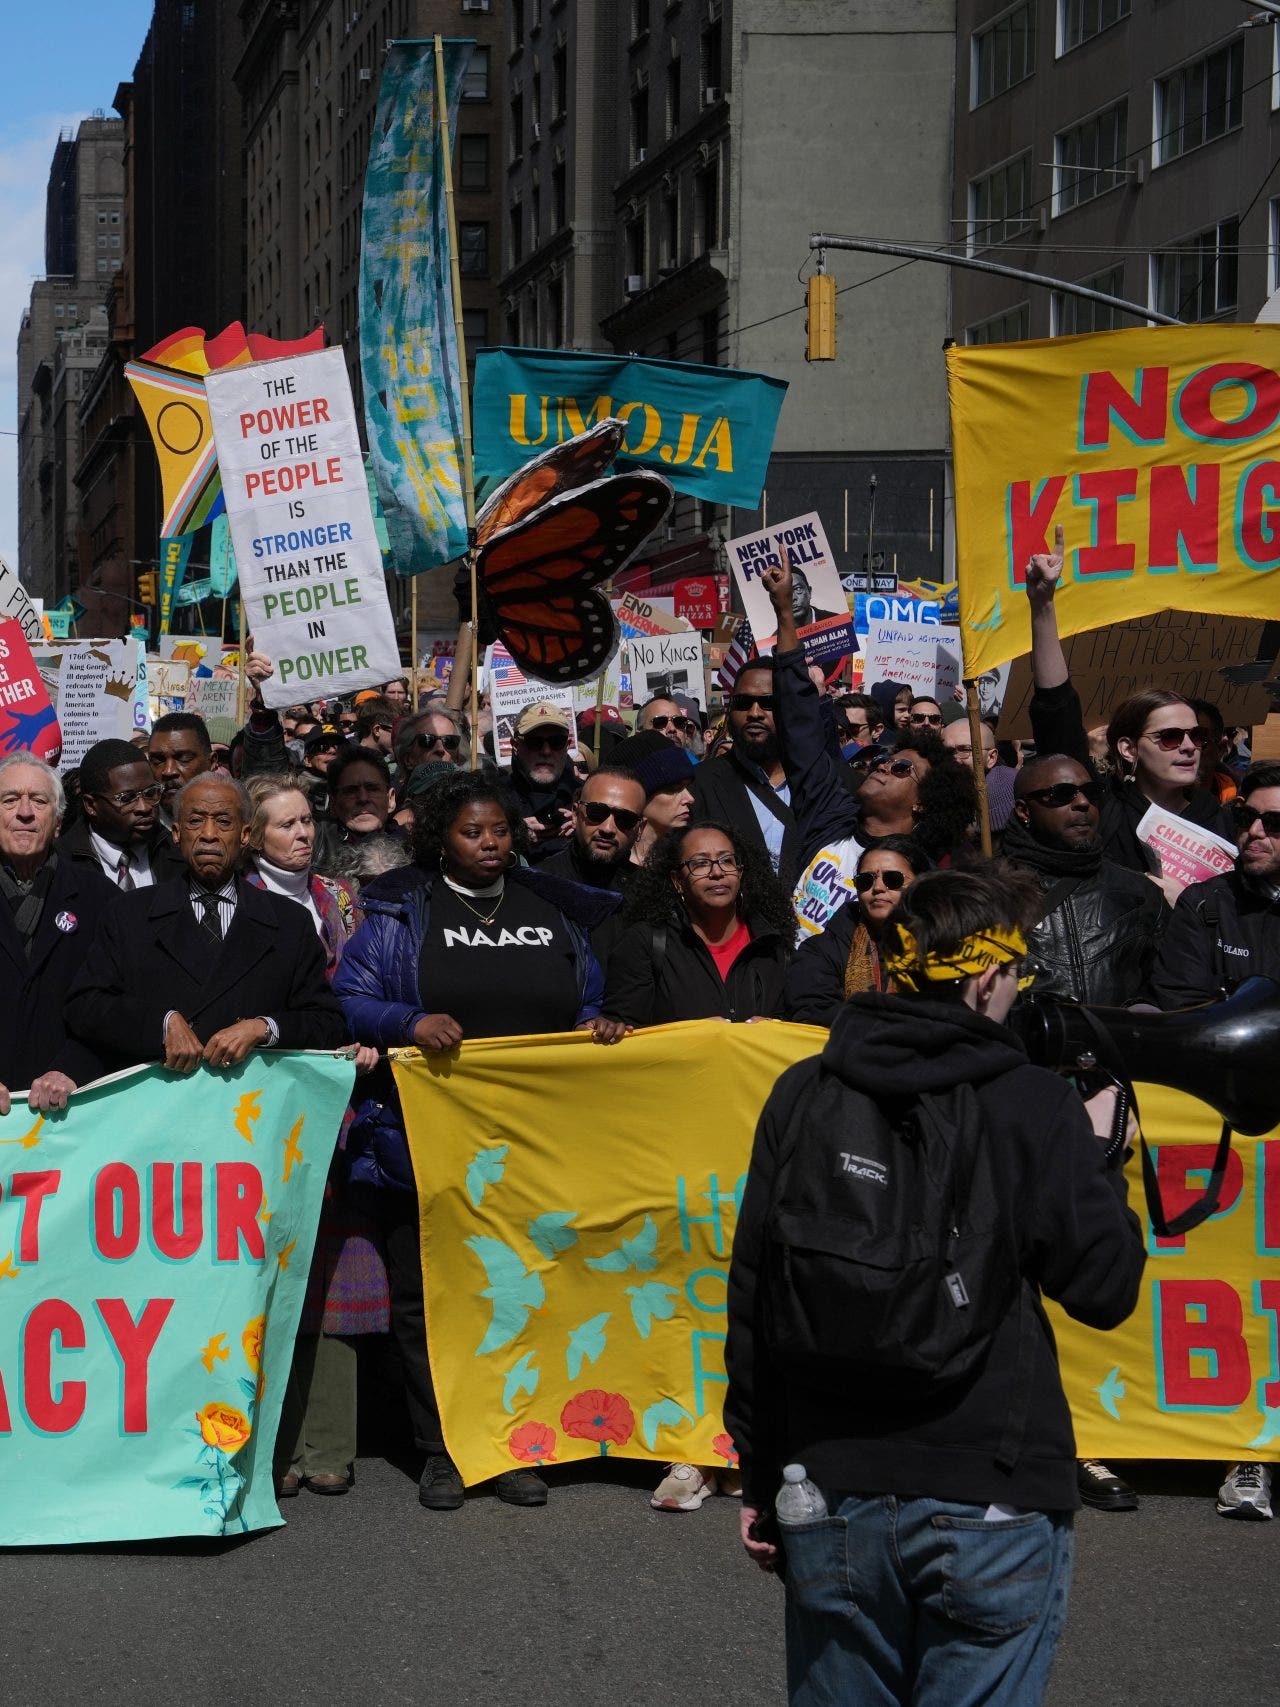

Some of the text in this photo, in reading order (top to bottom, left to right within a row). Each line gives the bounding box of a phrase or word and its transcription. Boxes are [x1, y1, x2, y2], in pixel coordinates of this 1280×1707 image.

[263, 377, 297, 398] THE
[240, 398, 331, 438] POWER
[1077, 362, 1280, 452] NO
[260, 434, 319, 460] OF THE
[508, 394, 734, 473] UMOJA
[245, 457, 344, 498] PEOPLE
[288, 502, 306, 519] IS
[252, 522, 353, 558] STRONGER
[736, 522, 818, 562] NEW YORK
[264, 553, 348, 583] THAN THE
[787, 540, 824, 569] ALL
[846, 579, 892, 587] ONE WAY
[263, 578, 362, 619] PEOPLE
[622, 594, 653, 618] END
[679, 604, 712, 612] RAY'S
[865, 597, 939, 626] OMG
[307, 620, 326, 639] IN
[810, 635, 828, 646] SHAH
[829, 629, 848, 641] ALAM
[878, 628, 956, 644] UNPAID AGITATOR
[631, 638, 698, 671] NO KINGS
[1125, 627, 1202, 666] THOSE
[69, 664, 85, 672] King
[279, 644, 370, 684] POWER
[875, 656, 892, 664] NOT
[895, 658, 919, 668] PROUD
[75, 673, 104, 682] deployed
[495, 688, 528, 699] EMPEROR
[529, 686, 548, 695] PLAYS
[500, 693, 567, 707] WHILE USA CRASHES
[63, 729, 85, 737] British
[1155, 824, 1233, 872] CHALLENGE
[1170, 852, 1180, 862] NO
[1180, 858, 1197, 871] FEAR
[803, 897, 829, 929] CLU
[443, 926, 553, 947] NAACP
[840, 1152, 888, 1185] TRACK
[88, 1162, 267, 1269] OUR
